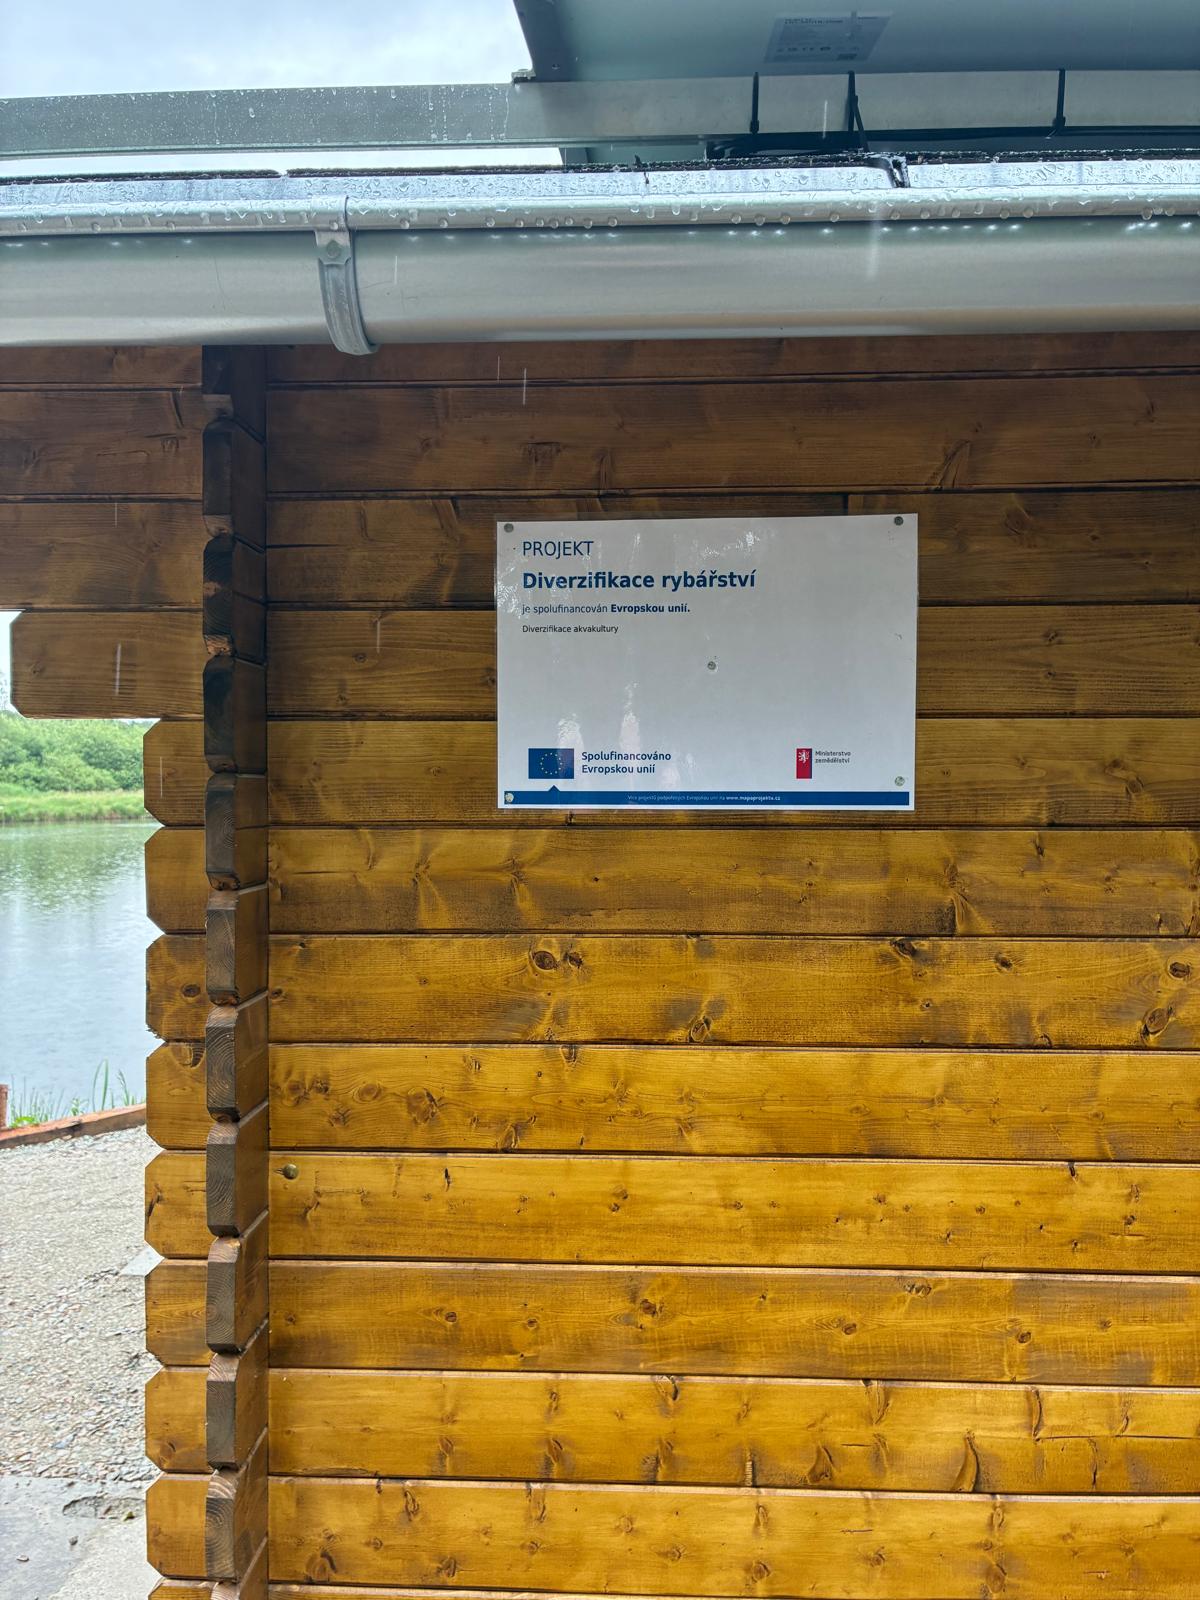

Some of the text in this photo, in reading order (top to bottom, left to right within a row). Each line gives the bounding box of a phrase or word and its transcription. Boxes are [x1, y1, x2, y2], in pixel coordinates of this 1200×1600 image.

[522, 541, 594, 559] PROJEKT
[522, 568, 757, 592] Diverzifikace rybářství
[521, 603, 691, 614] je spolufinancován Evropskou unií.
[522, 624, 619, 634] Diverzifikace akvakultury
[581, 751, 672, 762] Spolufinancováno
[581, 764, 655, 775] Evropskou unií
